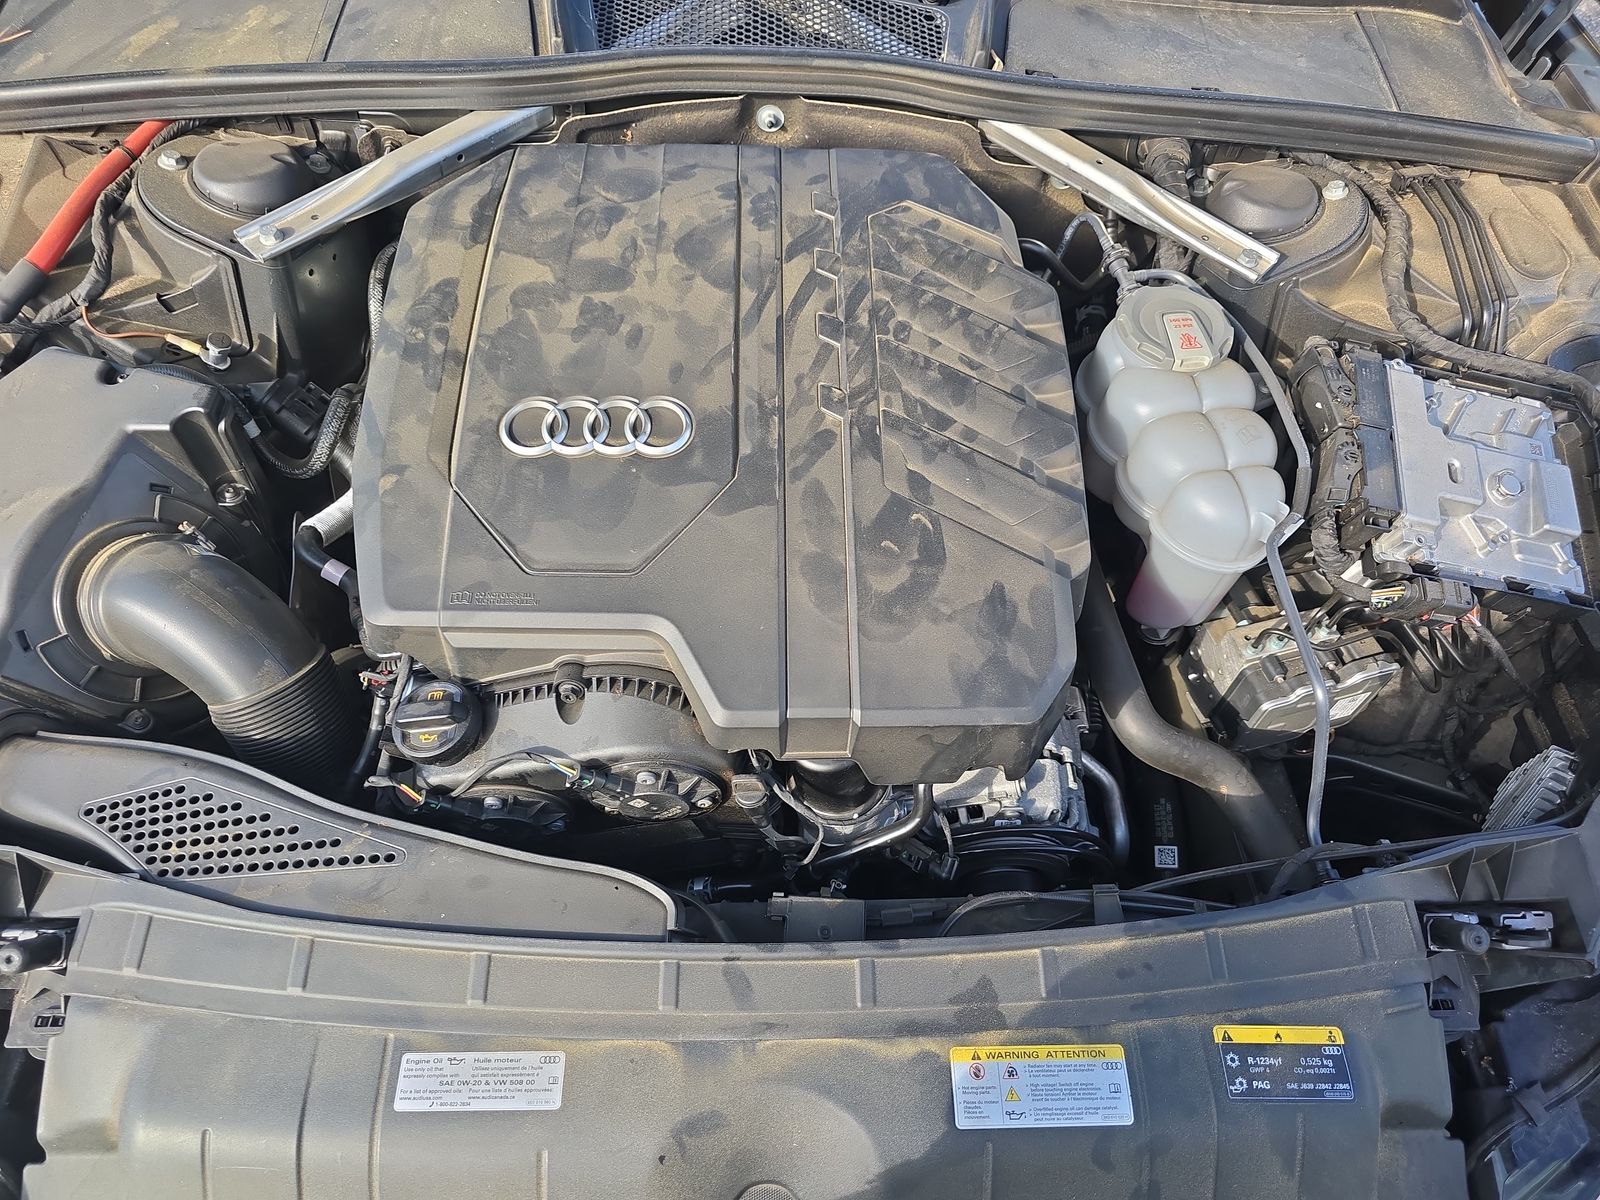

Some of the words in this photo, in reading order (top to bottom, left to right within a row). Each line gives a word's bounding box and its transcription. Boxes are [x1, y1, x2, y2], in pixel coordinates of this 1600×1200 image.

[984, 1051, 1040, 1060] WARNING
[1045, 1049, 1106, 1058] ATTENTION
[1247, 1057, 1282, 1067] R-1234yf
[1300, 1058, 1321, 1066] 0,525
[1323, 1058, 1333, 1067] kg
[1253, 1081, 1271, 1089] PAG
